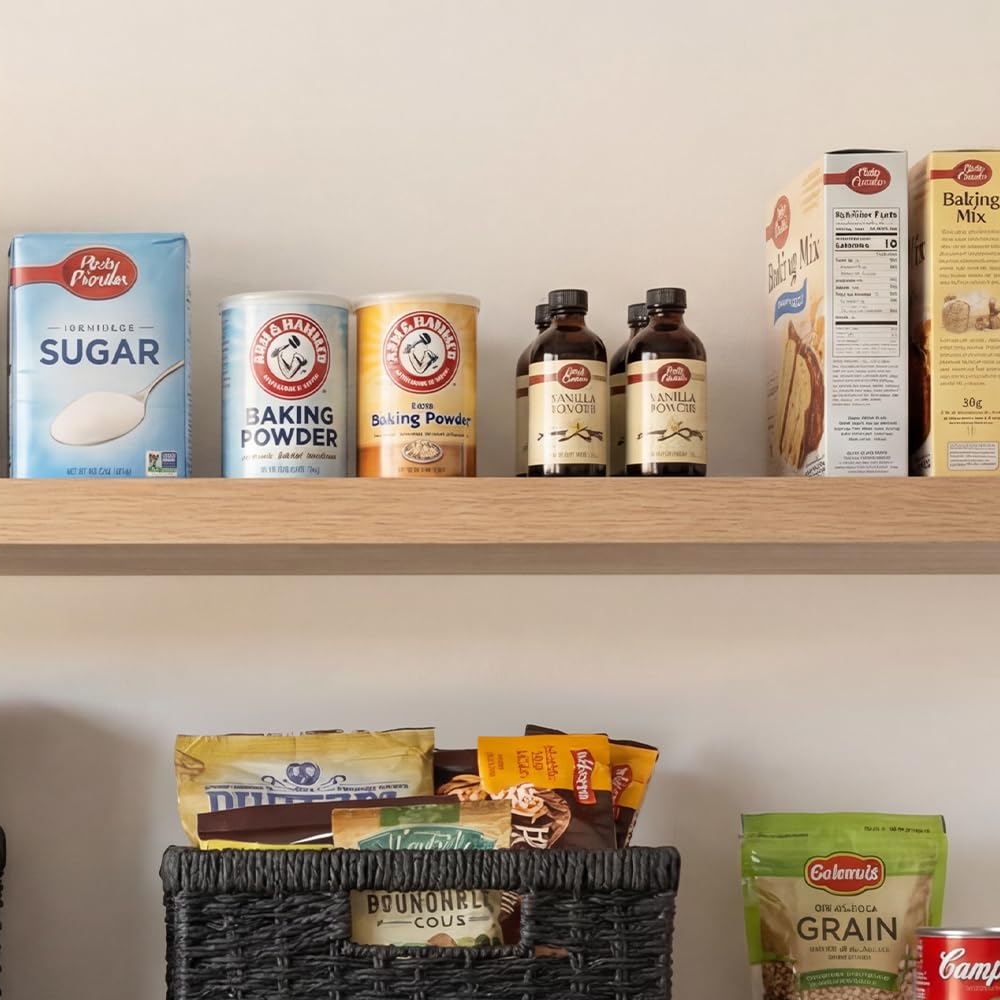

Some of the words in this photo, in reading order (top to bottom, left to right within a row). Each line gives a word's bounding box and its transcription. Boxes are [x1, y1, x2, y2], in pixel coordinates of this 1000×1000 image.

[957, 209, 986, 223] Mix
[40, 339, 159, 366] SUGAR
[246, 406, 333, 425] BAKING
[371, 412, 420, 427] Baking
[241, 428, 337, 448] POWDER
[415, 916, 465, 928] COUS
[797, 917, 897, 941] GRAIN
